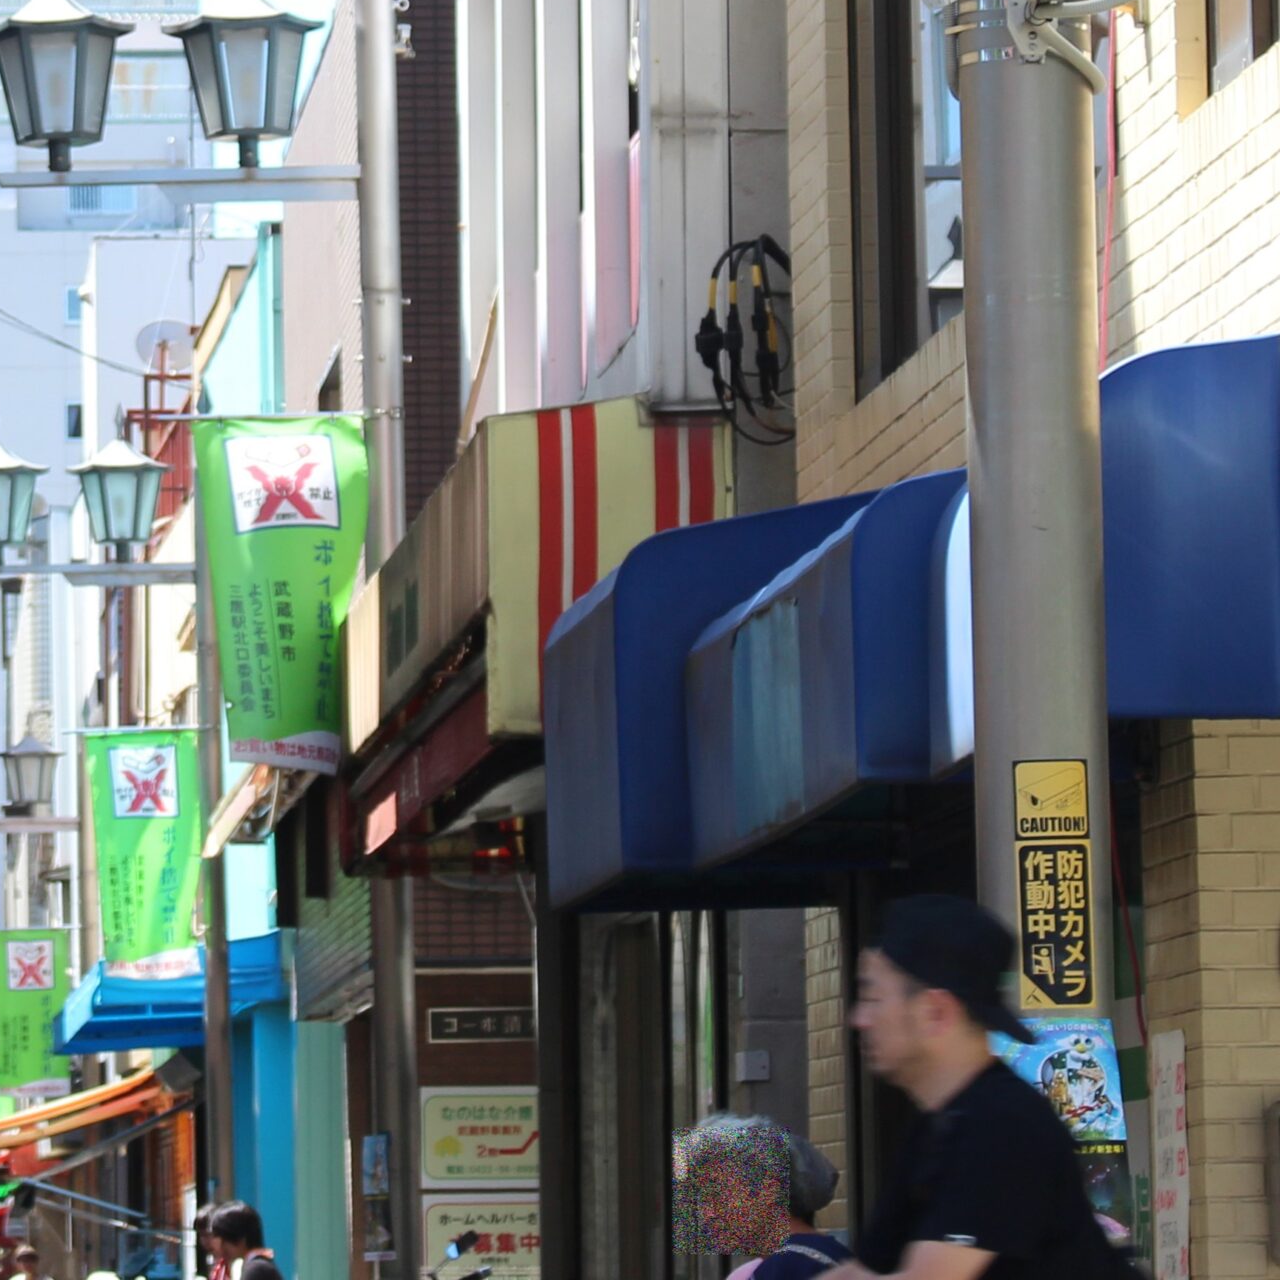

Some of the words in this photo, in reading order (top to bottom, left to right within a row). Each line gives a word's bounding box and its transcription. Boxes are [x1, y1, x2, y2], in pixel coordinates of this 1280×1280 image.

[274, 581, 296, 662] 武蔵野市
[1020, 816, 1085, 833] CAUTION!
[1024, 850, 1056, 940] 作動中
[1056, 849, 1087, 997] 防犯カメラ
[449, 1232, 541, 1254] 募集中
